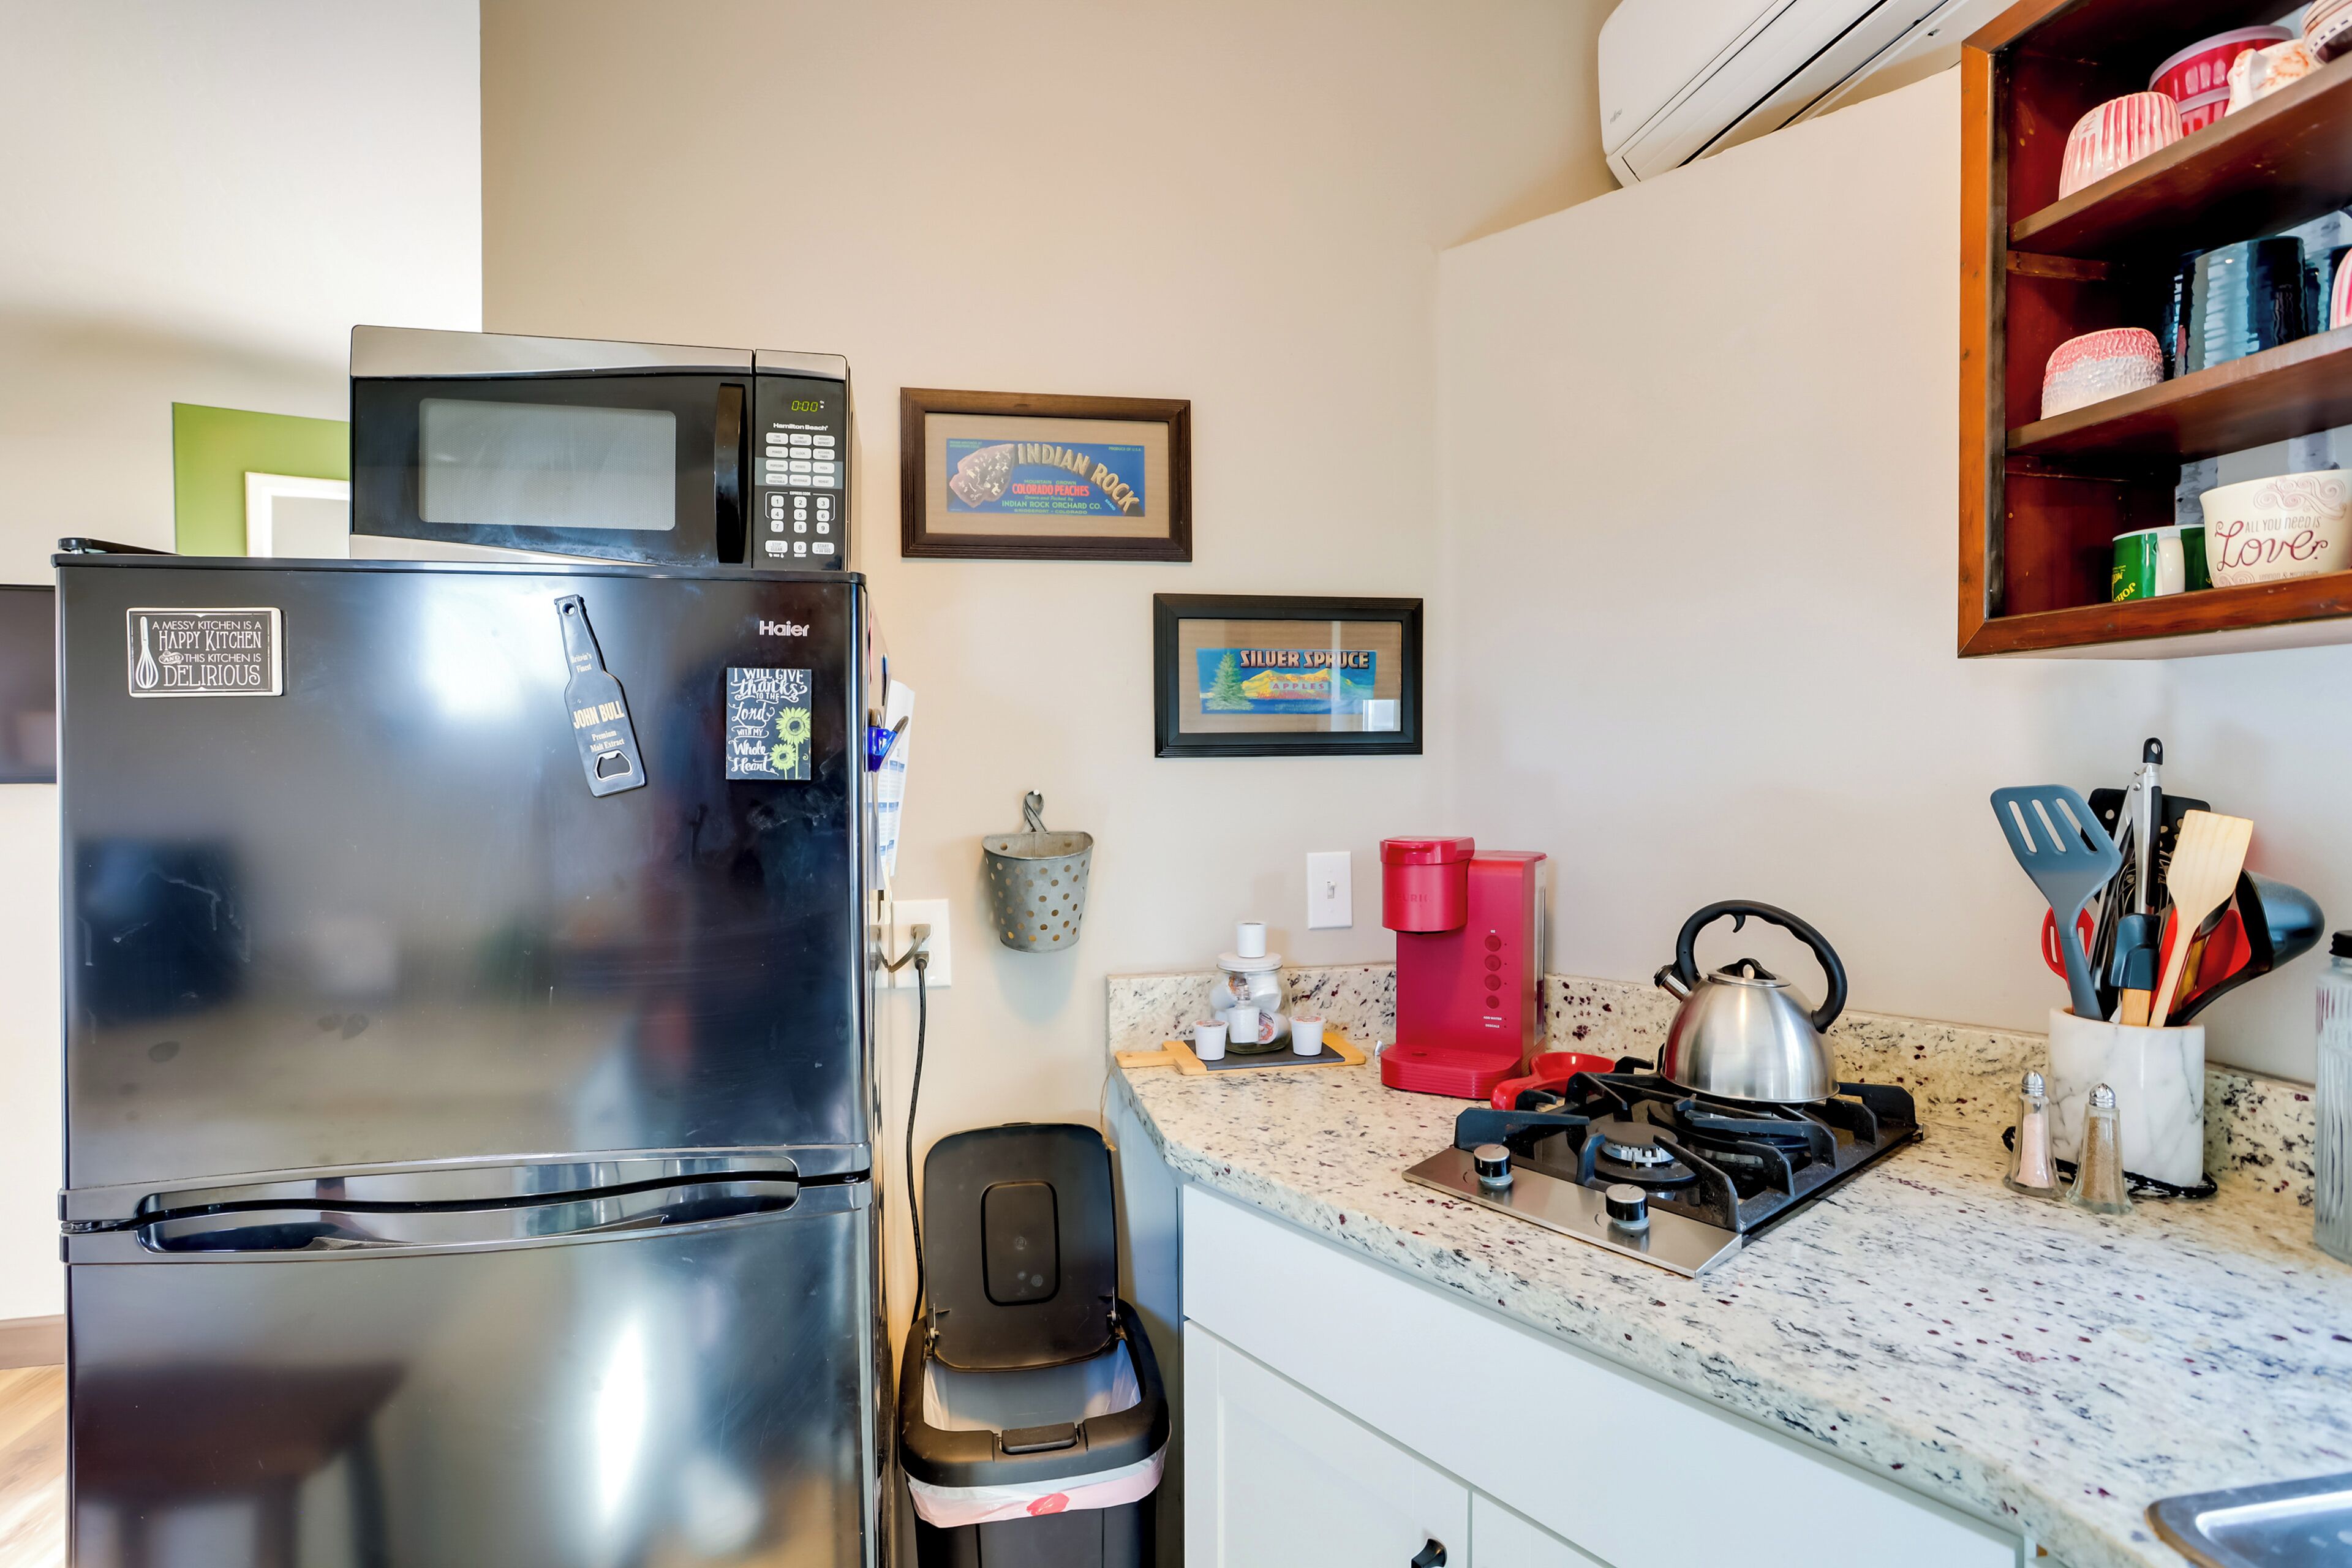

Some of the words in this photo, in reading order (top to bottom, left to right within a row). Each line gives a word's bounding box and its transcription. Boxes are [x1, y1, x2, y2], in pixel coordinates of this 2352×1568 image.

[791, 400, 819, 412] 0:00
[1017, 443, 1091, 478] INDIAN
[1091, 462, 1140, 513] ROCK
[1012, 483, 1054, 495] COLORADO
[1055, 484, 1090, 497] PEACHES
[2245, 521, 2260, 533] ALL
[2263, 518, 2282, 531] YOU
[2312, 516, 2322, 529] IS
[152, 620, 160, 630] A
[162, 621, 195, 630] MESSY
[198, 621, 241, 630] KITCHEN
[243, 621, 252, 630] IS
[254, 621, 262, 630] A
[759, 620, 810, 637] Haier
[159, 630, 201, 651] HAPPY
[205, 630, 262, 651] KITCHEN
[184, 654, 205, 662] THIS
[208, 654, 251, 662] KITCHEN
[253, 654, 262, 662] IS
[1239, 650, 1301, 668] SILVER
[1303, 650, 1370, 669] SPRUCE
[163, 665, 260, 687] DELIRIOUS
[576, 663, 592, 673] Finest
[734, 668, 739, 682] I
[742, 668, 774, 680] WILL
[775, 669, 804, 685] GIVE
[730, 678, 808, 696] thanks
[573, 706, 600, 729] JOHN
[598, 700, 625, 723] BULL
[729, 701, 775, 723] Lord
[591, 730, 617, 742] Premium
[736, 727, 752, 736] WITH
[590, 743, 603, 753] Malt
[603, 738, 625, 749] Extract
[728, 739, 770, 756] Whole
[728, 755, 779, 776] Heart
